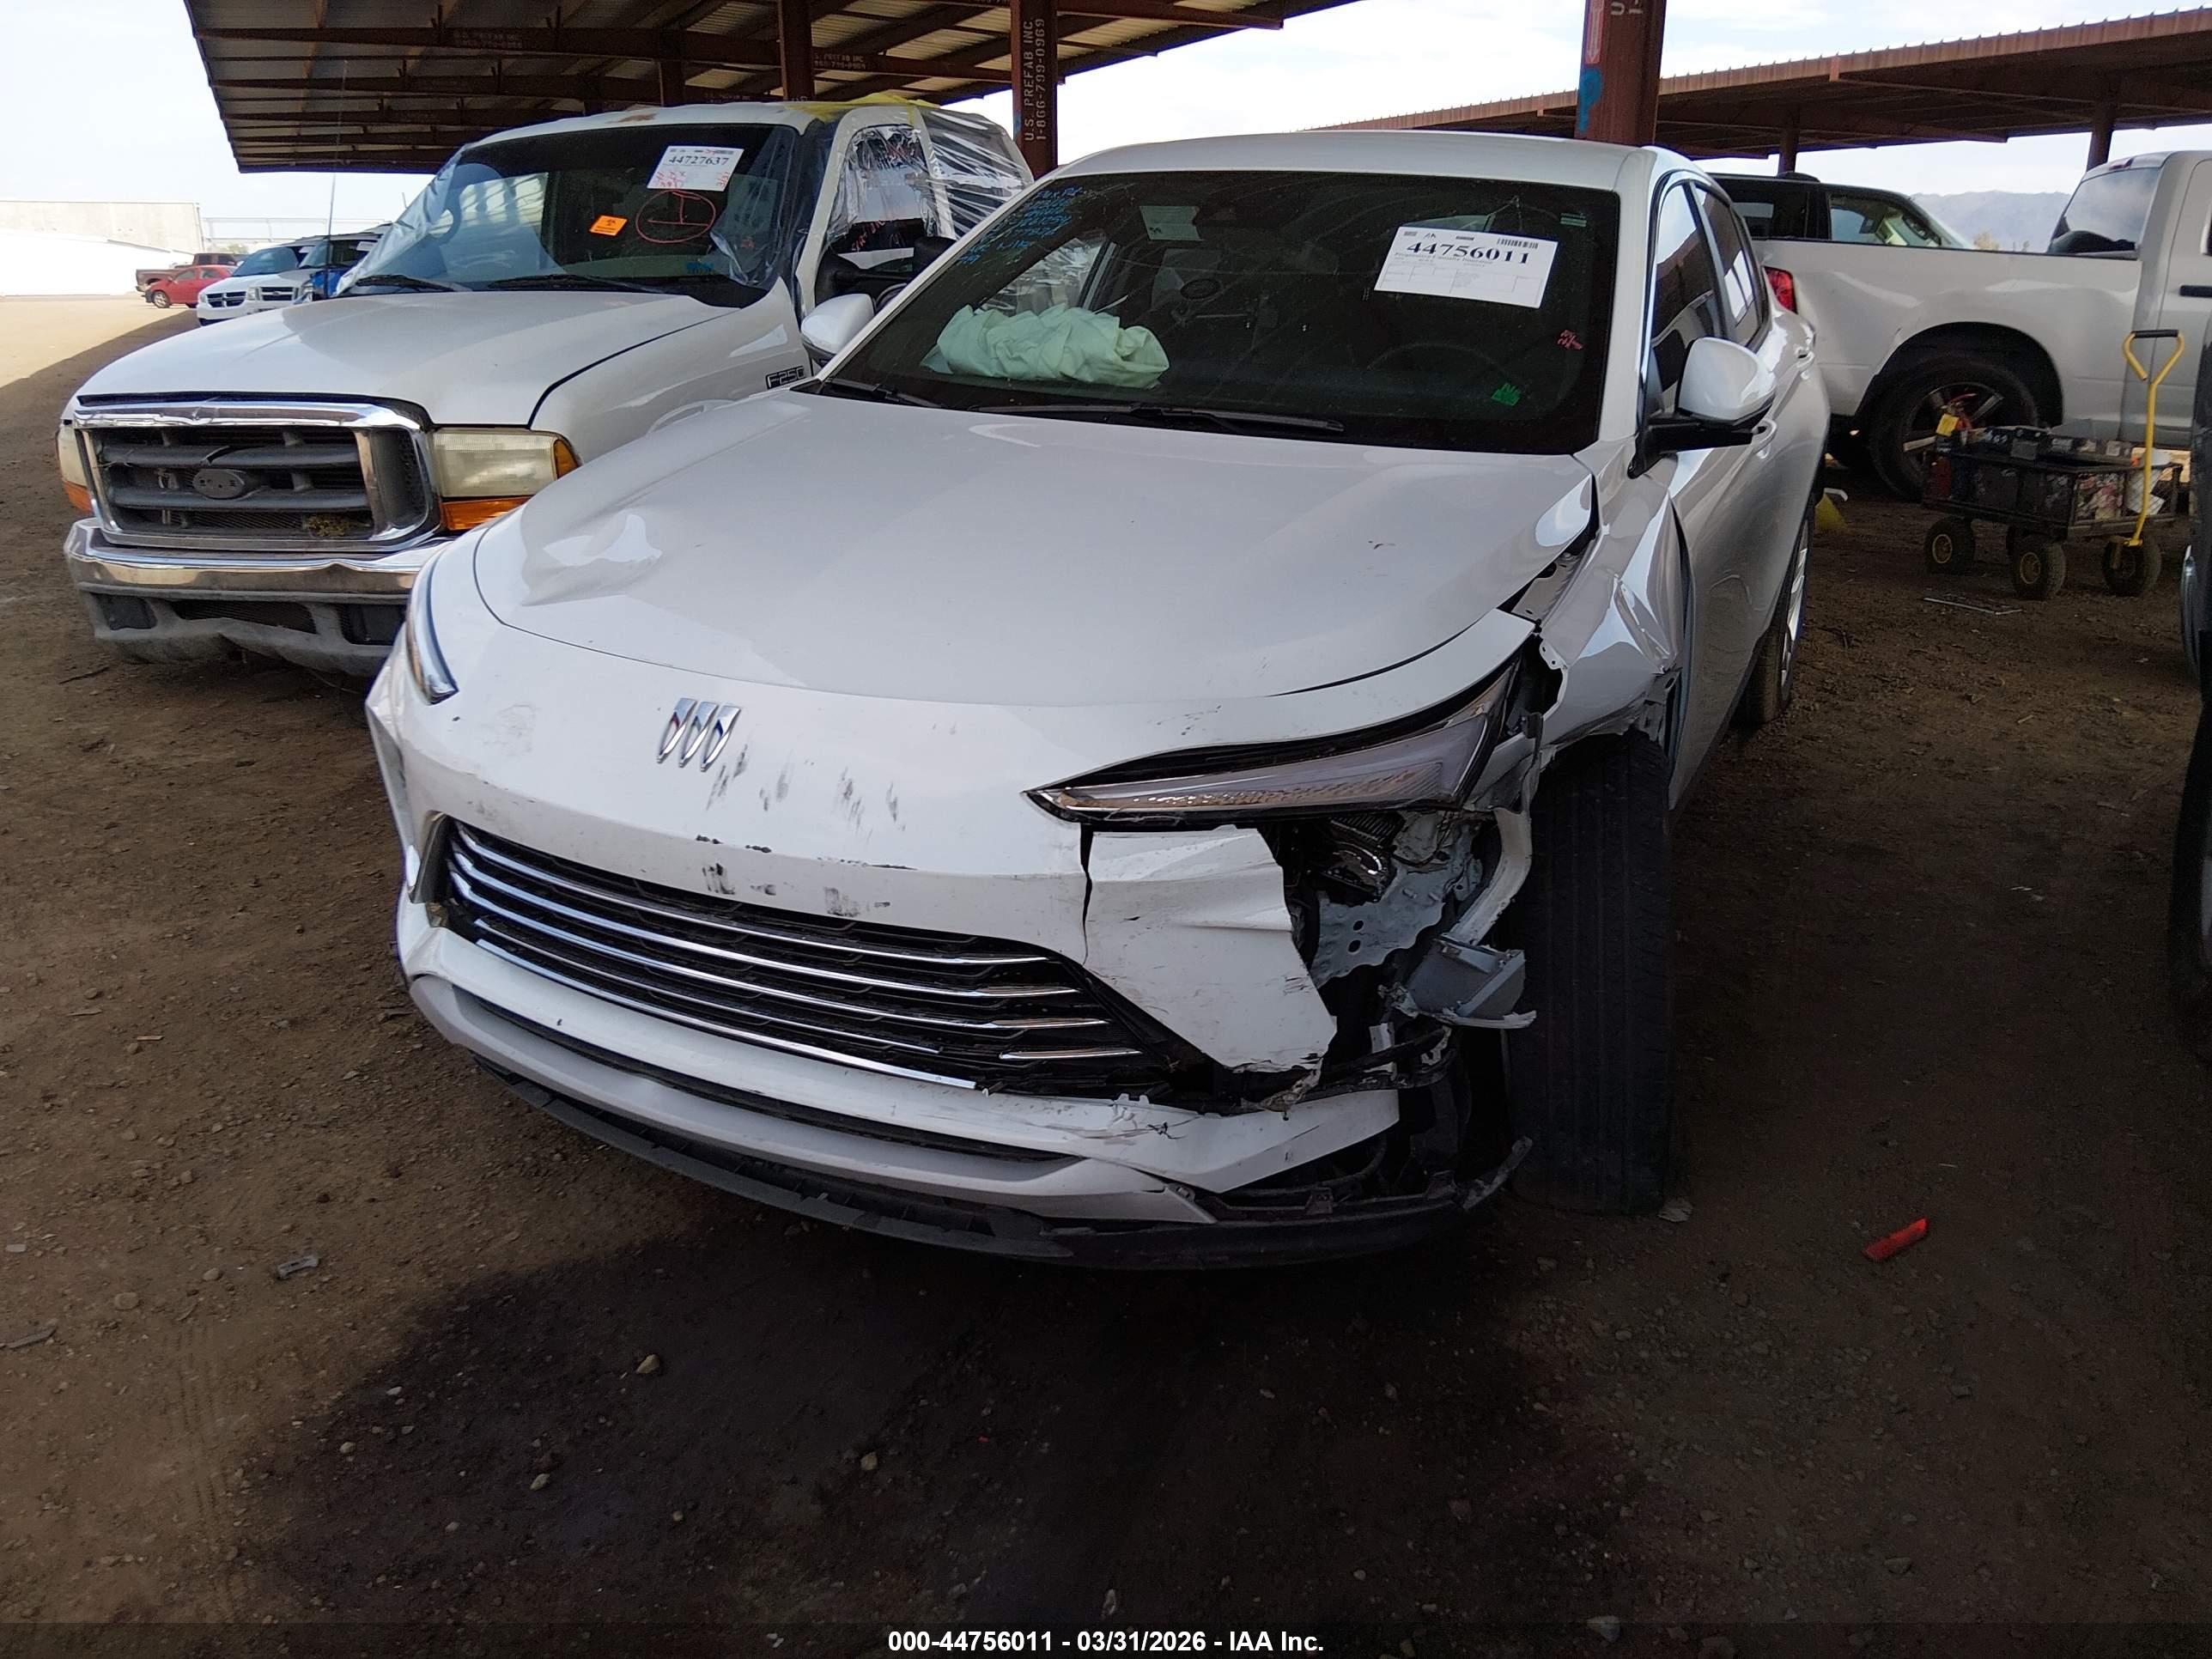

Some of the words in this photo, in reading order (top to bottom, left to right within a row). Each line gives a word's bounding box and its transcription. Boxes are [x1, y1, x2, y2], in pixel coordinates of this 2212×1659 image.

[1023, 52, 1034, 106] PREFAB
[1035, 18, 1047, 140] 1-866-799-0969
[668, 155, 730, 166] 44727637
[1407, 241, 1530, 264] 44756011
